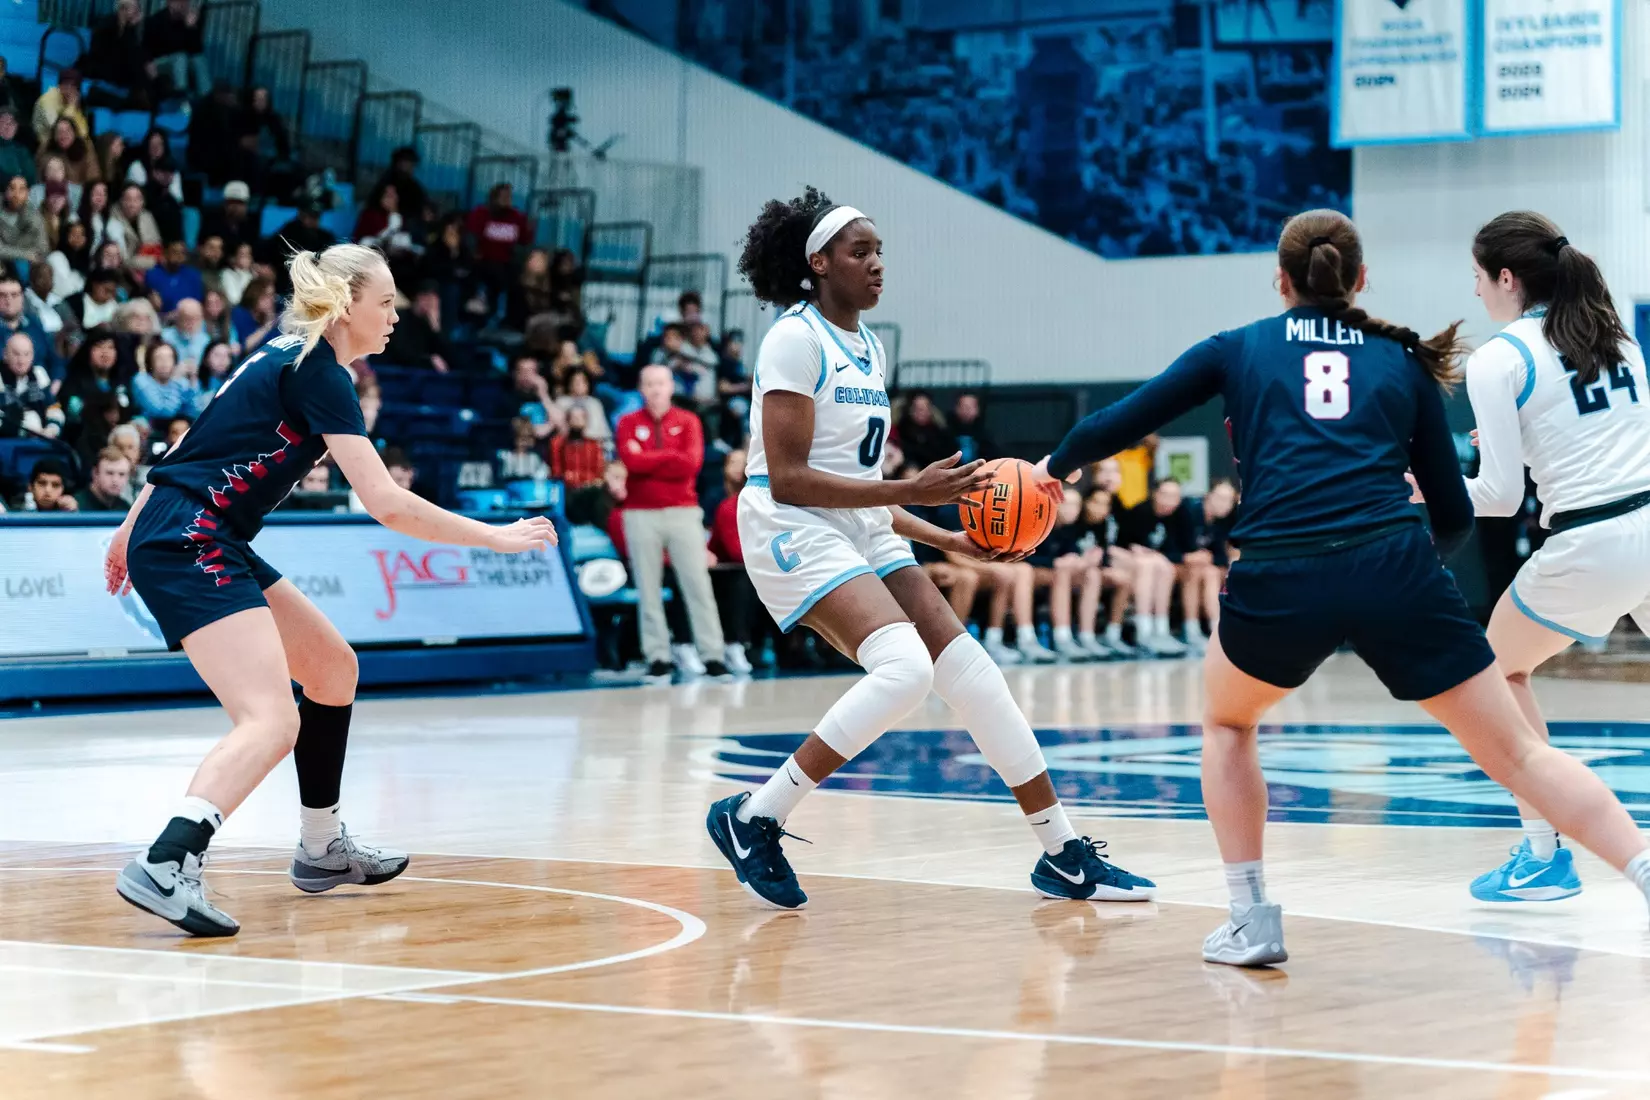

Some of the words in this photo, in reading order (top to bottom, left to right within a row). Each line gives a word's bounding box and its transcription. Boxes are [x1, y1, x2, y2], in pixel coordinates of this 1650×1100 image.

[1286, 317, 1364, 345] MILLER
[1304, 350, 1350, 420] 8
[1557, 353, 1639, 417] 24
[857, 416, 885, 468] 0
[991, 482, 1009, 536] ELITE
[770, 530, 801, 573] C
[5, 573, 65, 598] LOVE!
[369, 549, 470, 620] JAG
[476, 569, 551, 587] THERAPY
